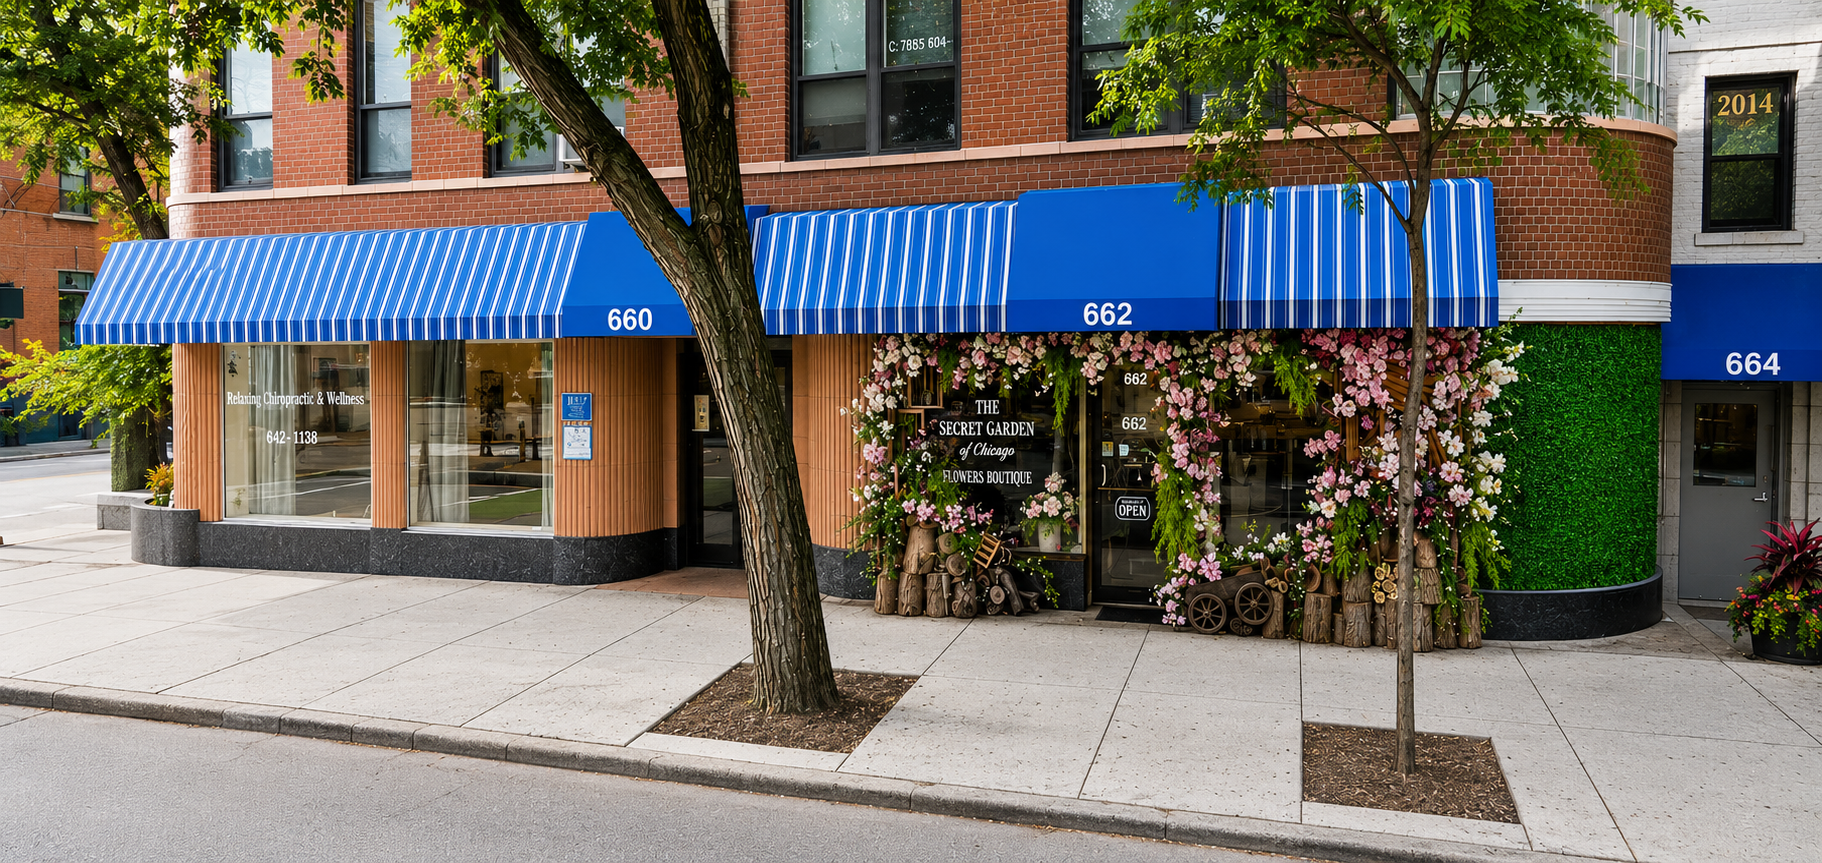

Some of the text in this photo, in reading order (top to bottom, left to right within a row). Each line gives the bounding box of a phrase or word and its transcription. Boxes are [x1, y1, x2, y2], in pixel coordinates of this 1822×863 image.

[888, 40, 899, 53] C:
[1717, 92, 1774, 116] 2014
[607, 307, 653, 331] 660
[1083, 302, 1132, 326] 662
[1725, 351, 1781, 376] 664
[1124, 372, 1148, 386] 662
[226, 391, 365, 408] Relaxing Chiropractic & Wellness
[975, 399, 1000, 415] THE
[939, 420, 1035, 436] SECRET GARDEN
[1121, 416, 1147, 431] 662
[959, 441, 1016, 462] of Chicago
[942, 469, 1033, 487] FLOWERS BOUTIQUE
[1118, 504, 1147, 517] OPEN
